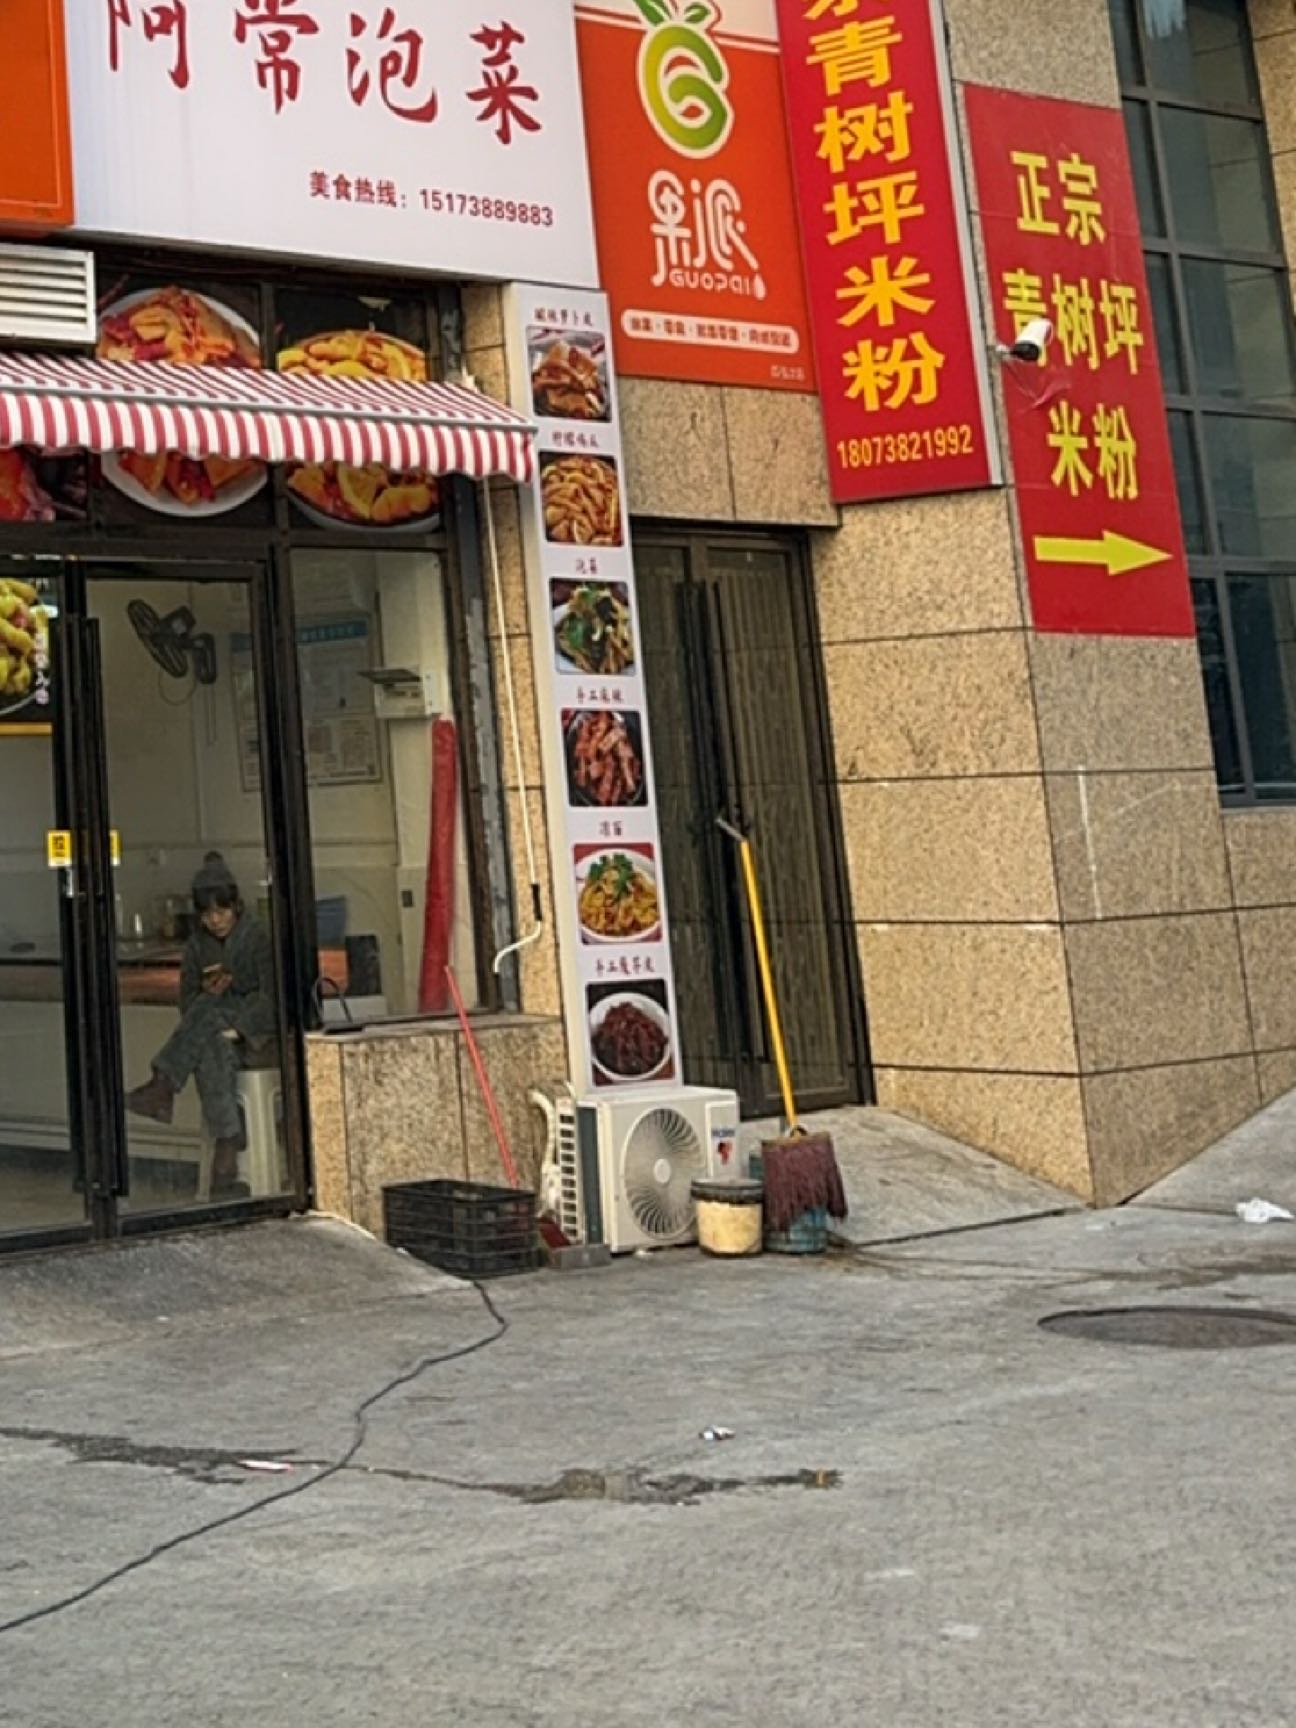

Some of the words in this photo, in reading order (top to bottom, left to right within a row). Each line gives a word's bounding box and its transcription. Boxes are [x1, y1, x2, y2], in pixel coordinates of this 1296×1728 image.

[1009, 150, 1105, 246] 正宗
[1002, 267, 1144, 375] 青树坪
[836, 424, 975, 469] 18073821992
[1046, 399, 1139, 500] 米粉
